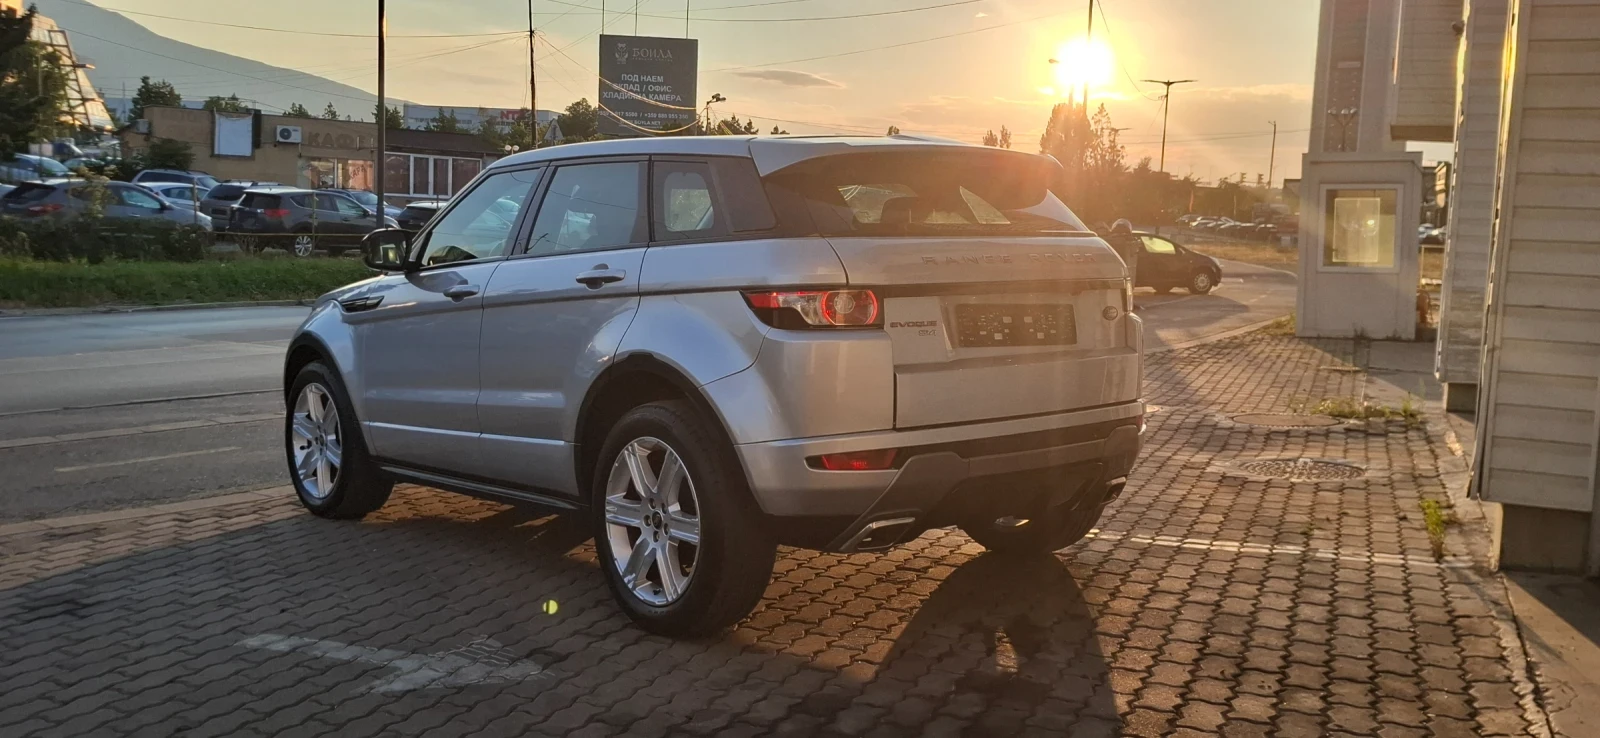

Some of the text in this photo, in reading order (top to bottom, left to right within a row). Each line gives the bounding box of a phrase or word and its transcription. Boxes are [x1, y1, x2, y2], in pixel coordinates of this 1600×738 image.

[621, 73, 664, 83] ПОД НАЕМ
[647, 84, 672, 93] ОФИС
[648, 93, 682, 102] КАМЕРА
[921, 252, 1097, 266] RANGE ROVER
[890, 320, 938, 328] EVOQUE
